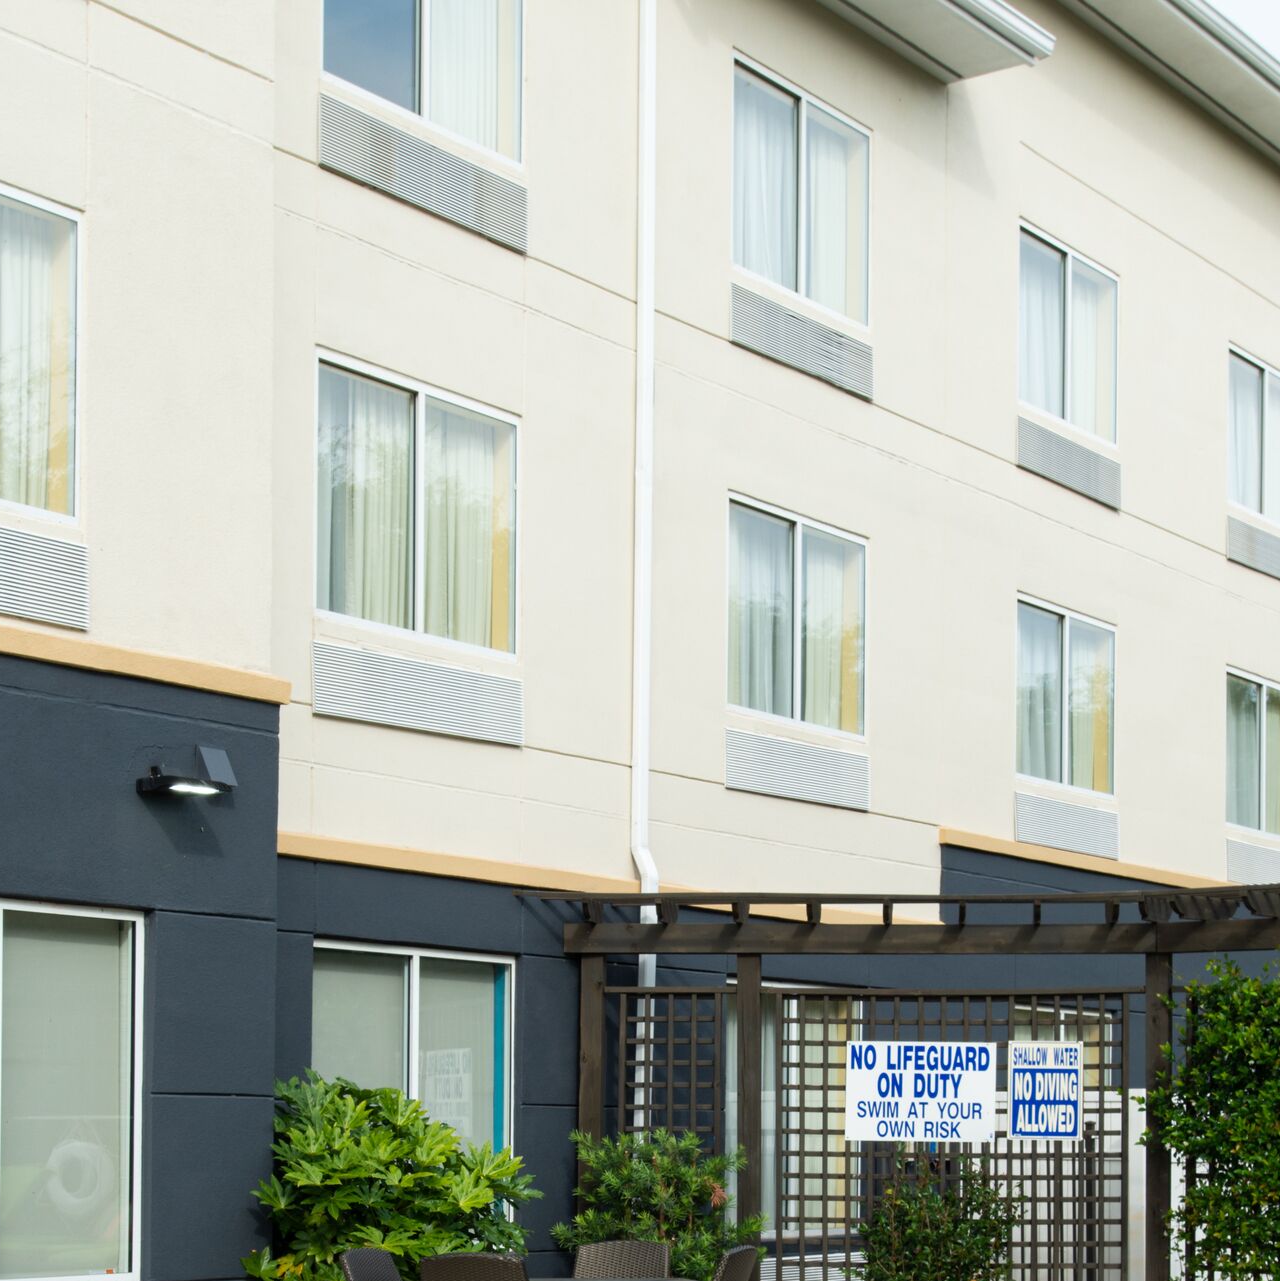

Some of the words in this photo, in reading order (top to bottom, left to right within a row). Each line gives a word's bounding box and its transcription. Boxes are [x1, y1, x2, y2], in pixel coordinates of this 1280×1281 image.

[850, 1045, 877, 1070] NO
[887, 1045, 990, 1071] LIFEGUARD
[1013, 1047, 1048, 1065] SHALLOW
[1053, 1048, 1078, 1066] WATER
[877, 1072, 903, 1098] ON
[913, 1073, 962, 1099] DUTY
[1014, 1072, 1033, 1101] NO
[1035, 1072, 1078, 1101] DIVING
[857, 1101, 899, 1118] SWIM
[907, 1102, 929, 1119] AT
[937, 1102, 982, 1120] YOUR
[1016, 1104, 1075, 1133] ALLOWED
[876, 1121, 915, 1138] OWN
[924, 1121, 961, 1138] RISK
